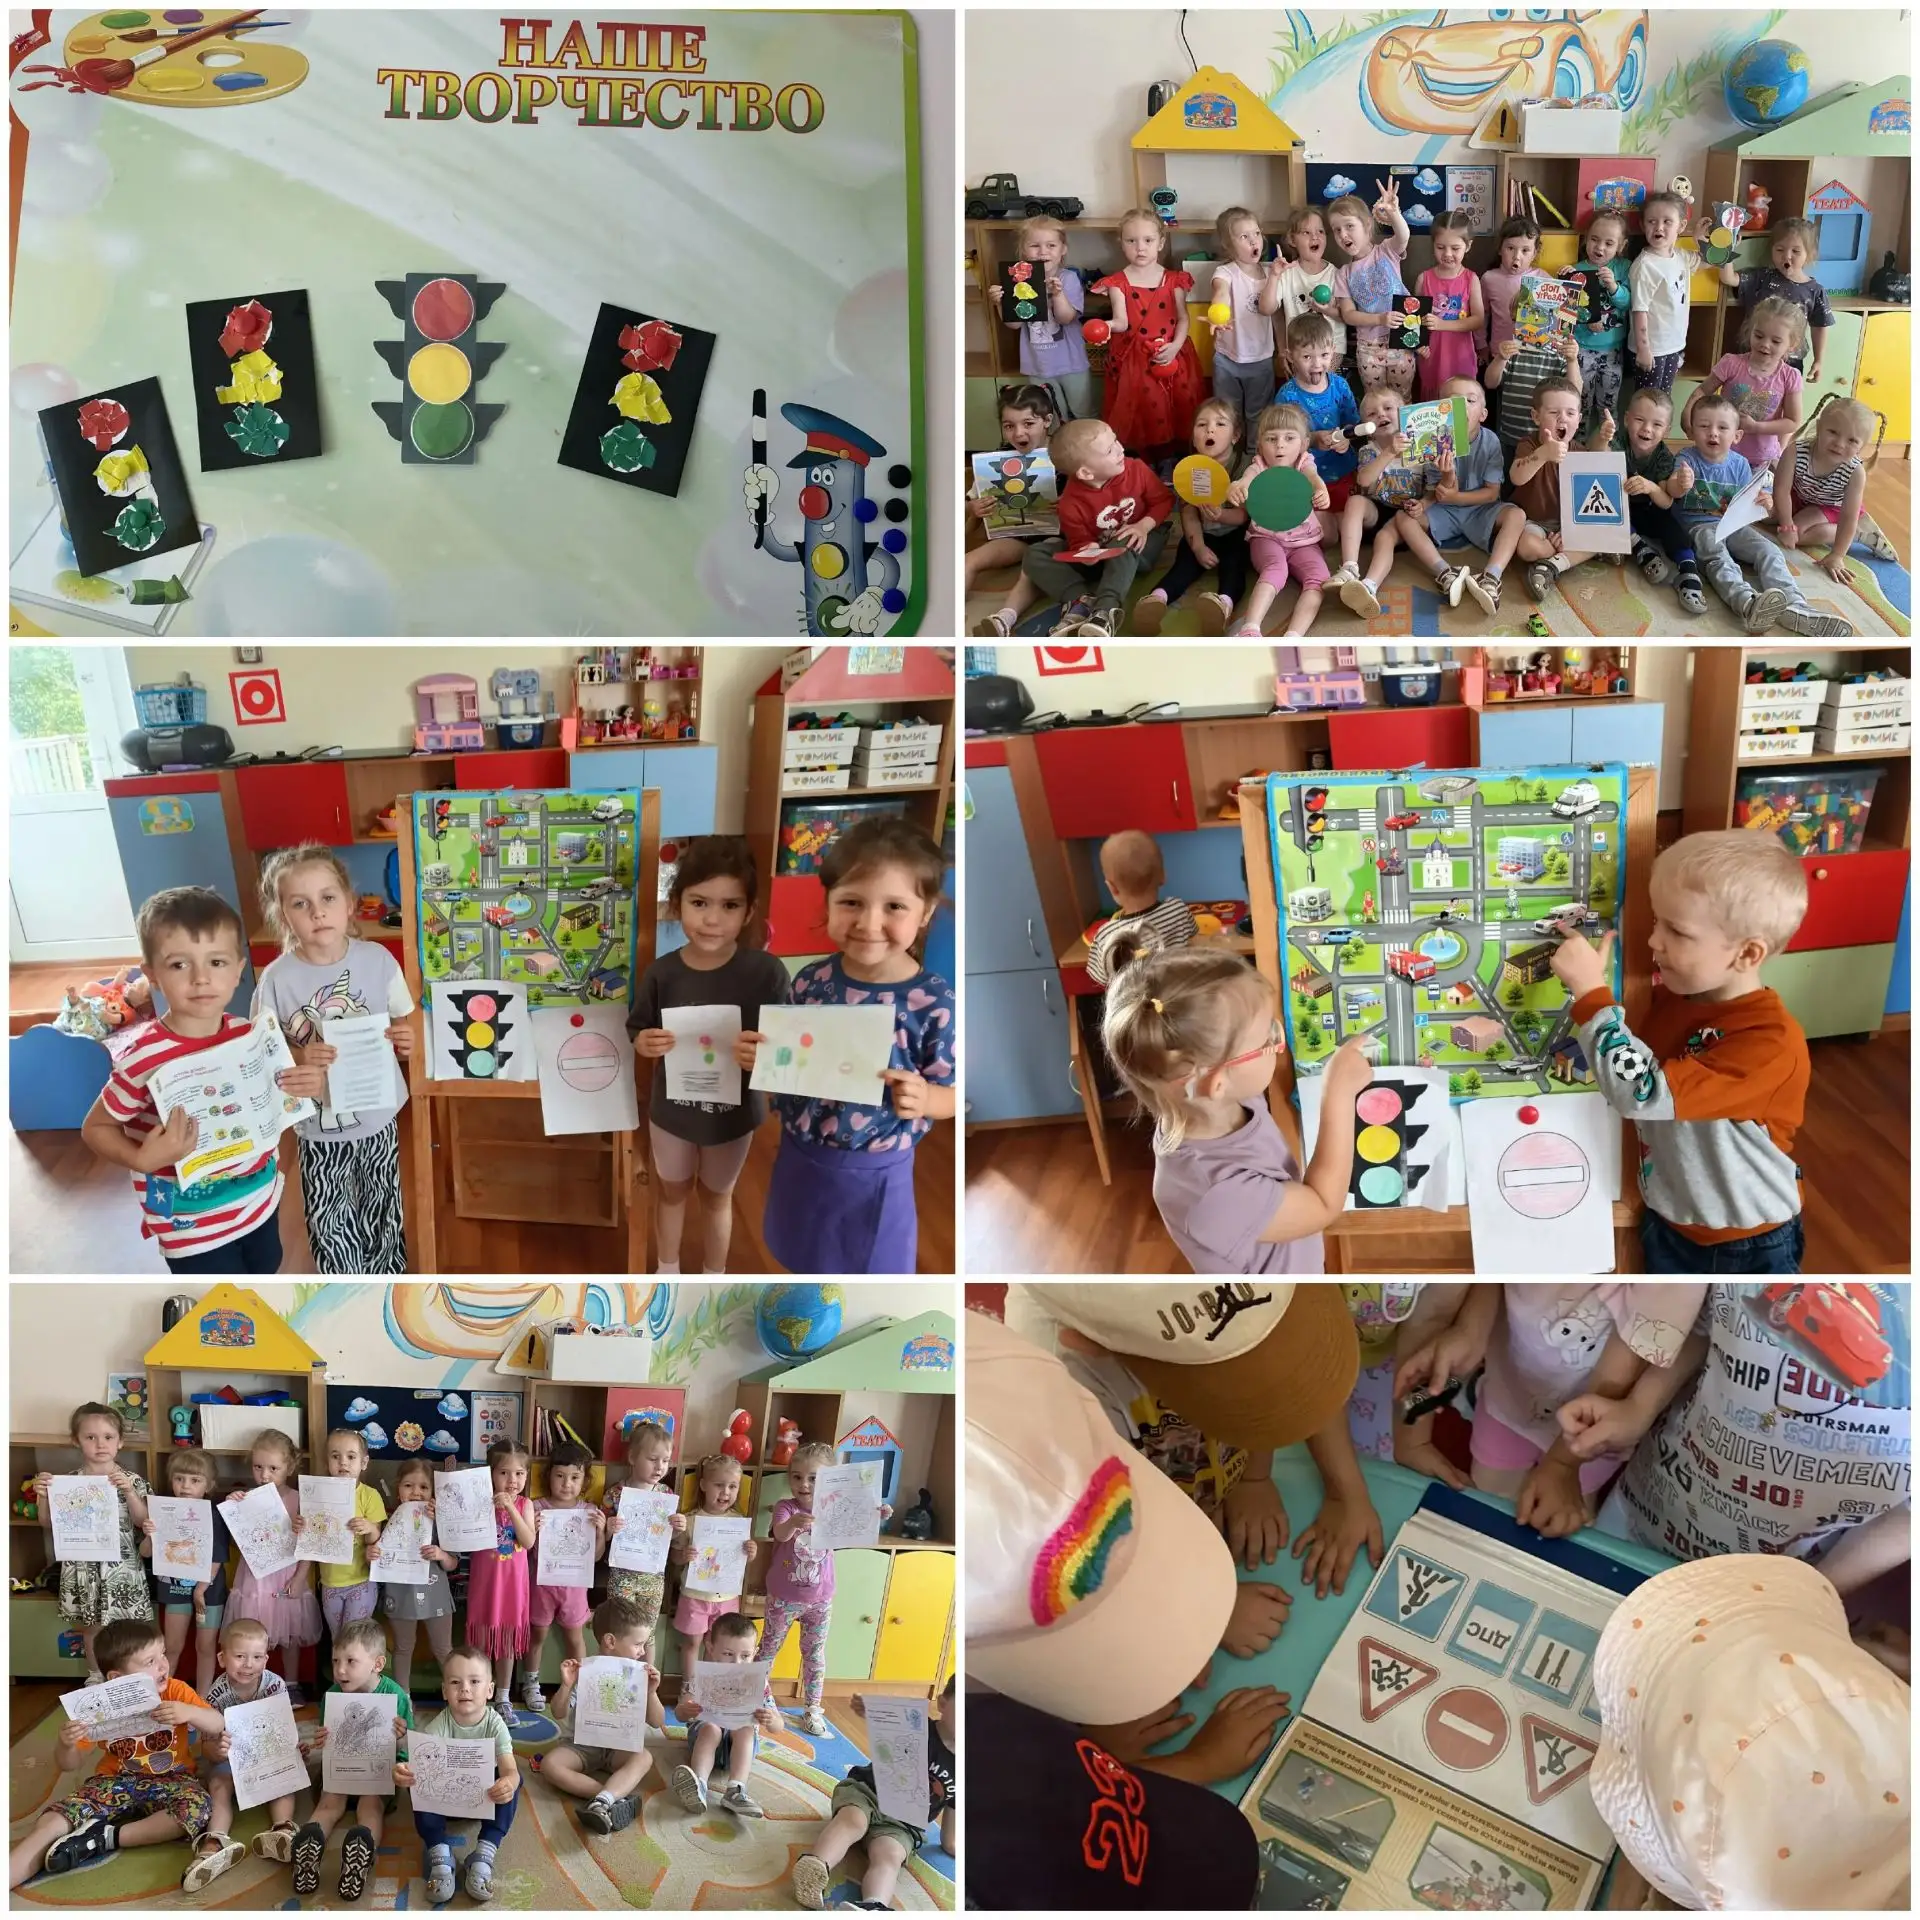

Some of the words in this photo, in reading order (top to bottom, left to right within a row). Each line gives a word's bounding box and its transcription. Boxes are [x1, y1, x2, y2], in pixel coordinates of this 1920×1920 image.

[498, 18, 707, 74] НАШЕ
[377, 68, 825, 134] ТВОРЧЕСТВО
[1813, 198, 1853, 211] ТЕАТР
[852, 1435, 887, 1447] ТЕАТР
[1732, 1474, 1790, 1508] OFF
[1466, 1621, 1512, 1649] ДПС
[1075, 1738, 1149, 1886] 23
